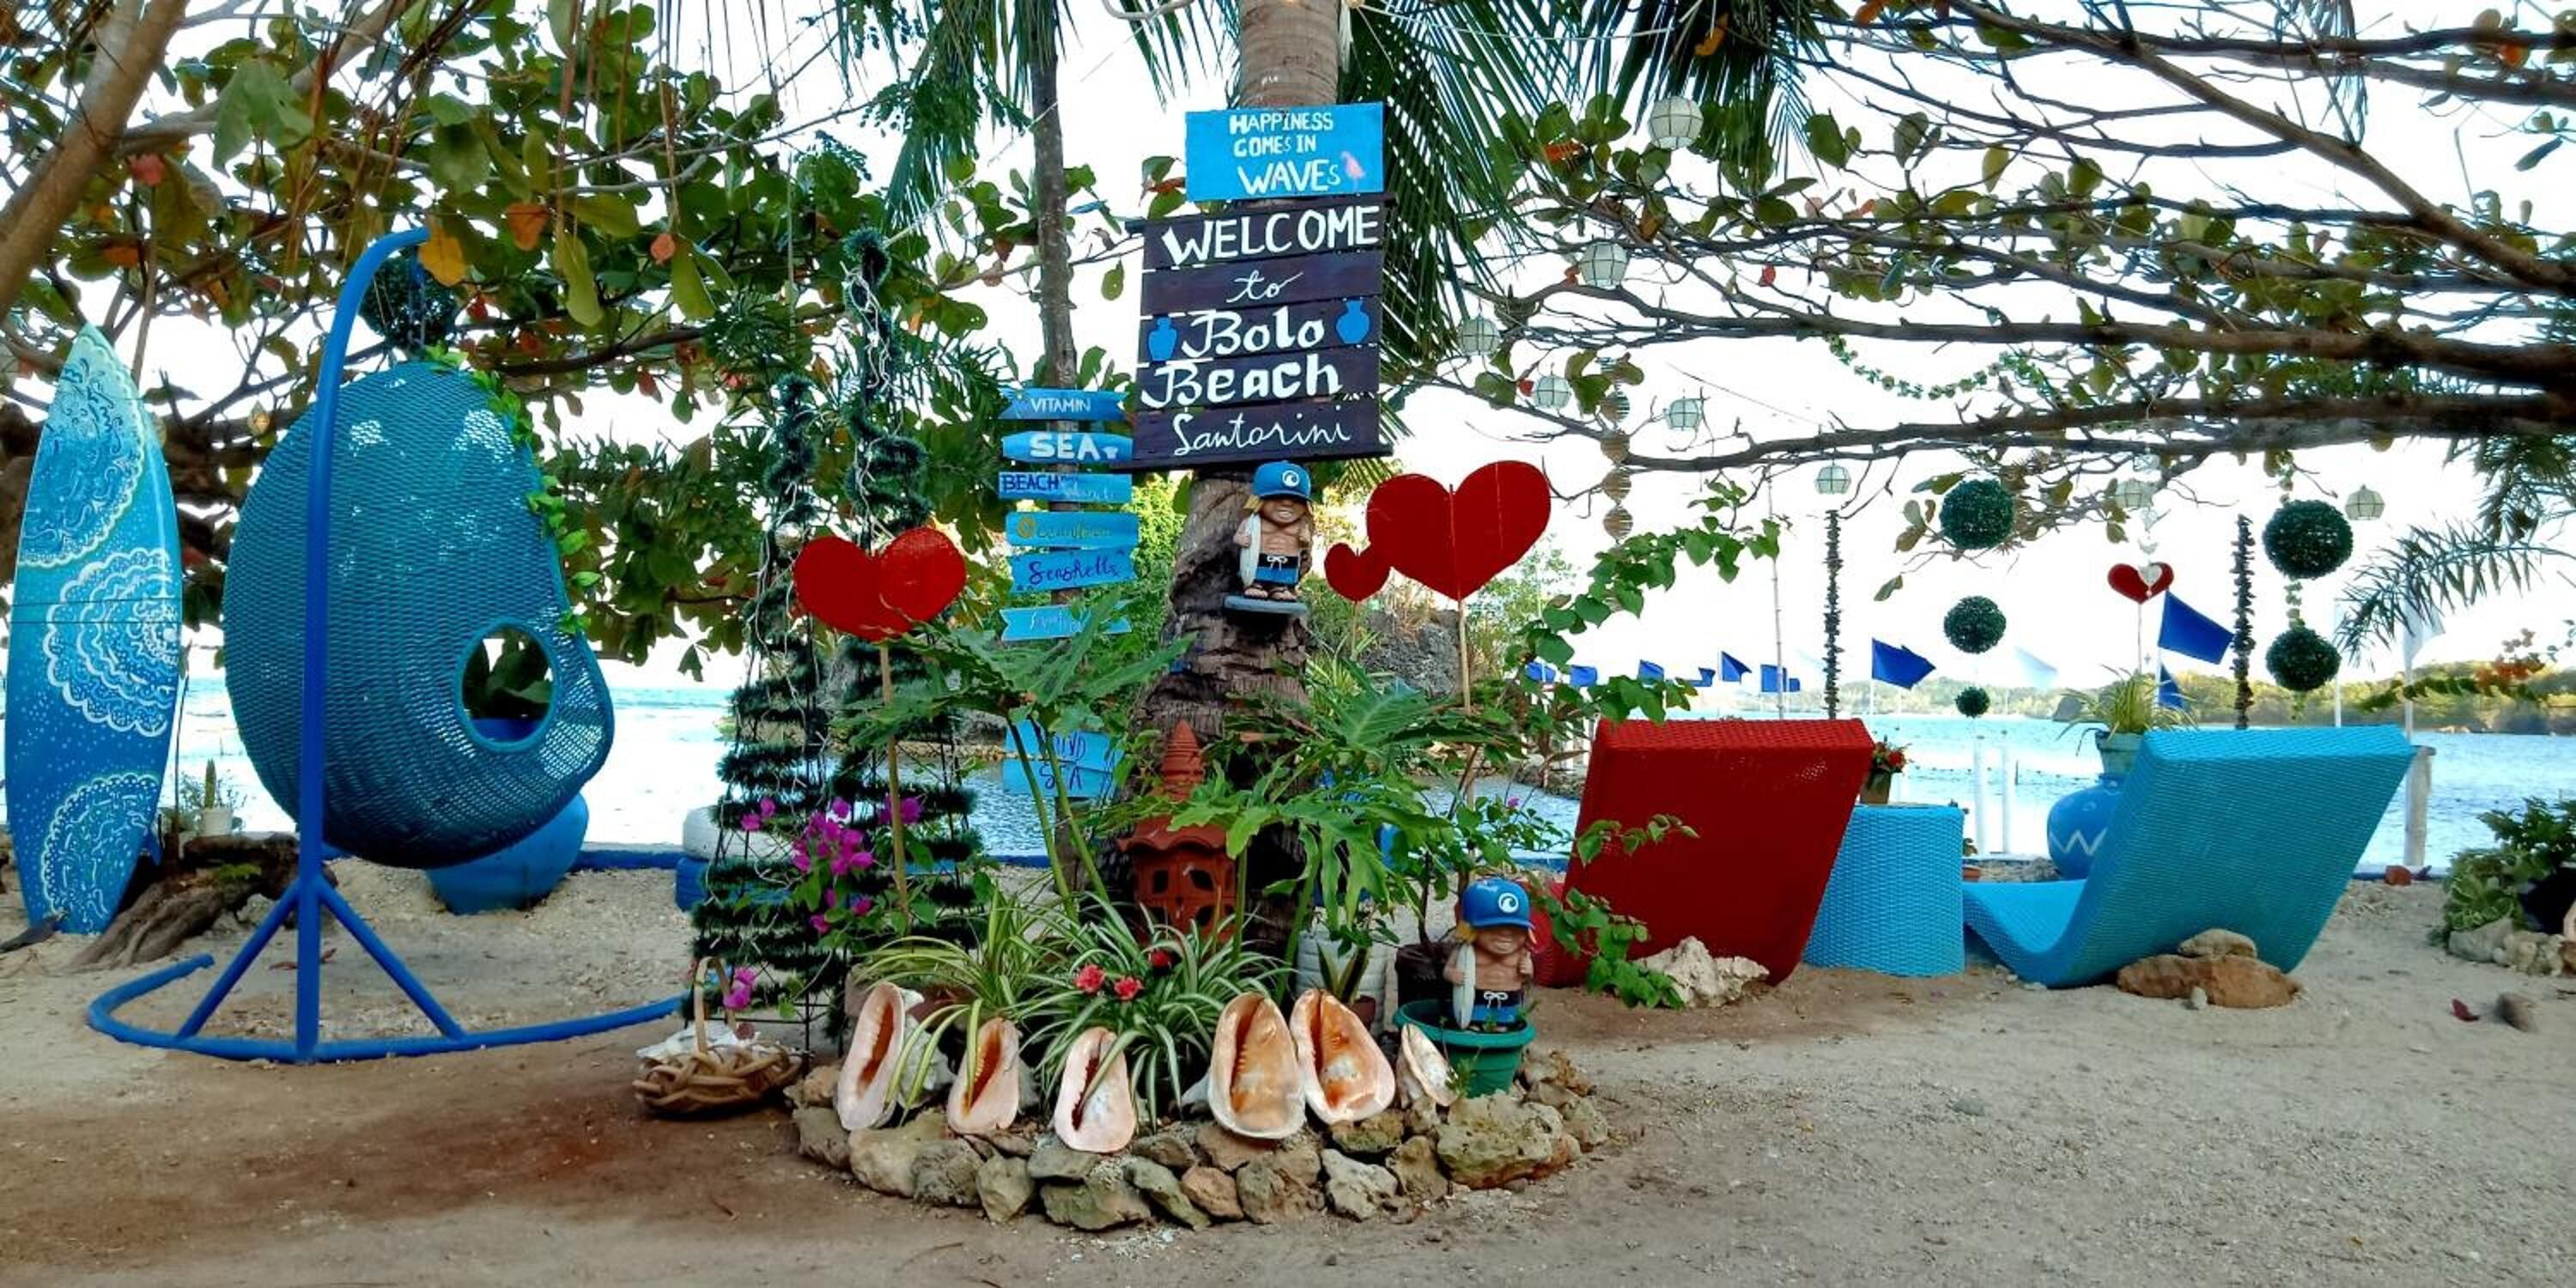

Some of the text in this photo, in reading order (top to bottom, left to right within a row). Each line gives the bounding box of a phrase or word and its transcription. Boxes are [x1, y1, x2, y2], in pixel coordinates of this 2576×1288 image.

[1230, 112, 1334, 135] HAPPINESS
[1234, 134, 1317, 157] COMES IN
[1236, 159, 1341, 195] WAVES
[1161, 205, 1380, 266] WELCOME
[1226, 269, 1304, 303] to
[1181, 306, 1325, 356] Bolo
[1140, 353, 1344, 409] Beach
[1030, 398, 1091, 413] VITAMIN
[1030, 431, 1101, 461] SEA
[1173, 405, 1352, 456] Santorini
[1001, 473, 1060, 492] BEACH
